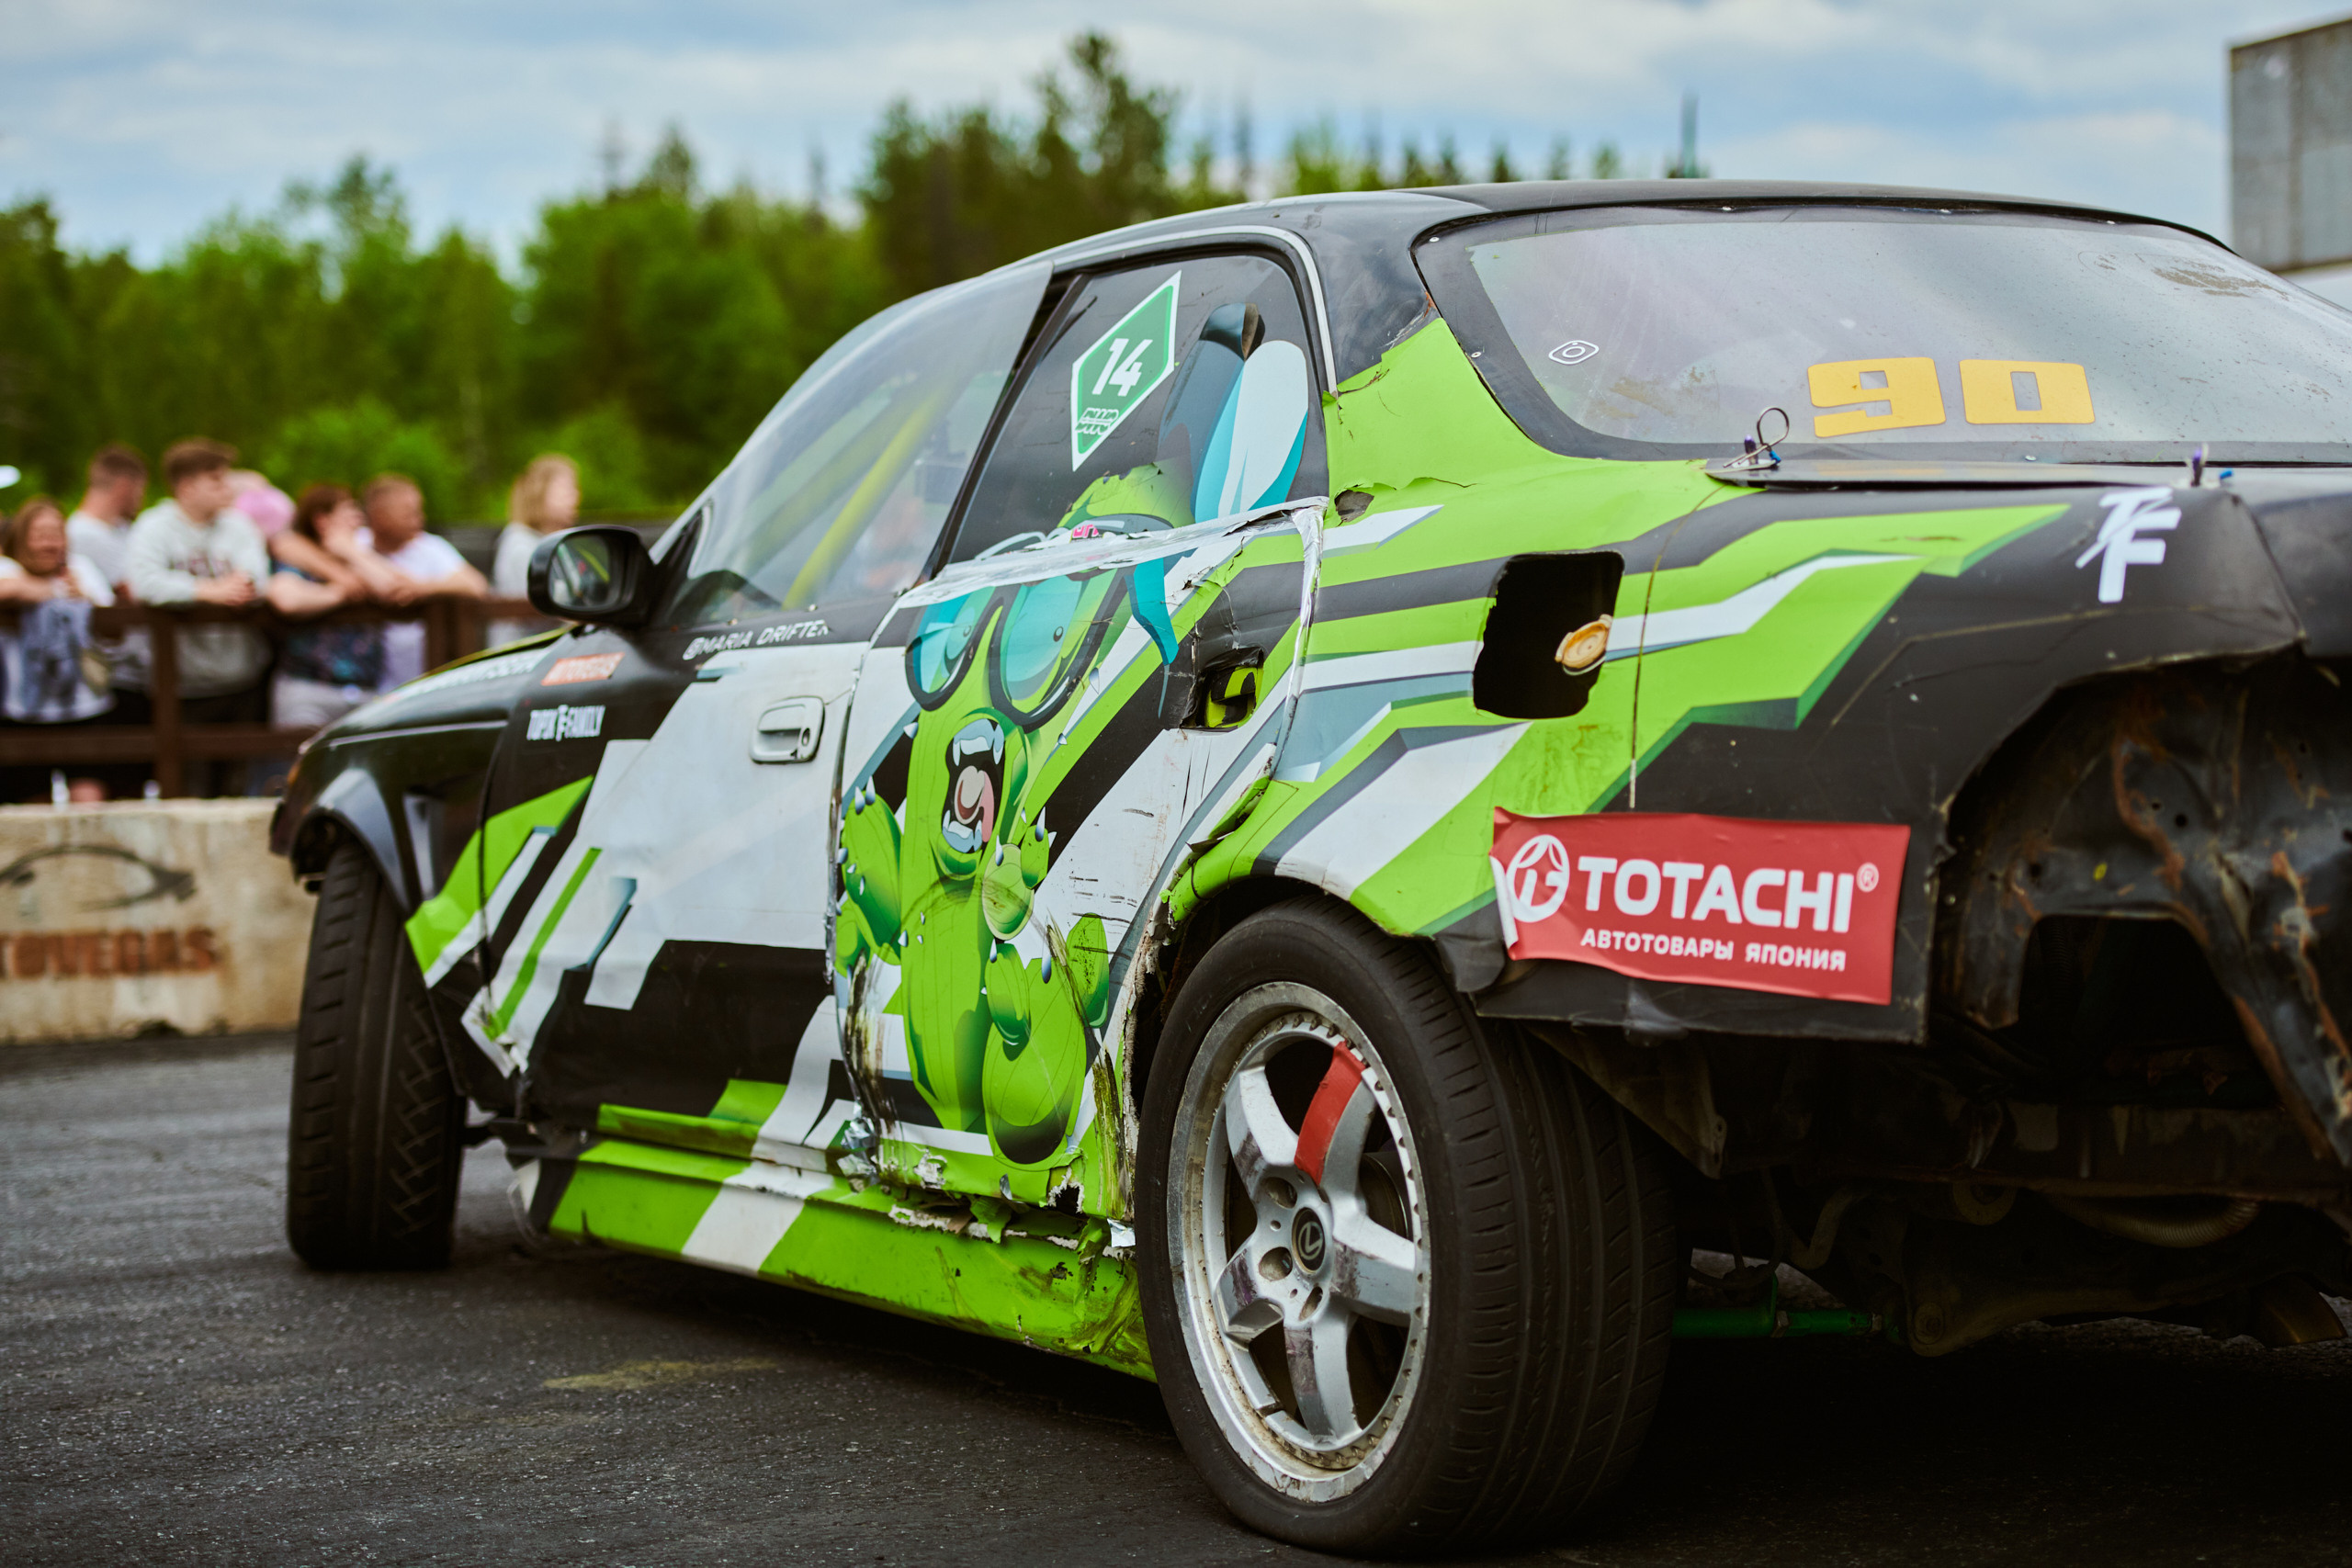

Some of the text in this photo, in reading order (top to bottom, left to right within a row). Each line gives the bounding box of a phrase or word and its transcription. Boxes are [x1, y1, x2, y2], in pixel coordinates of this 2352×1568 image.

[1091, 338, 1153, 397] 14
[1807, 357, 2096, 438] 90
[1580, 928, 1847, 972] АВТОТОВАРЫ ЯПОНИЯ
